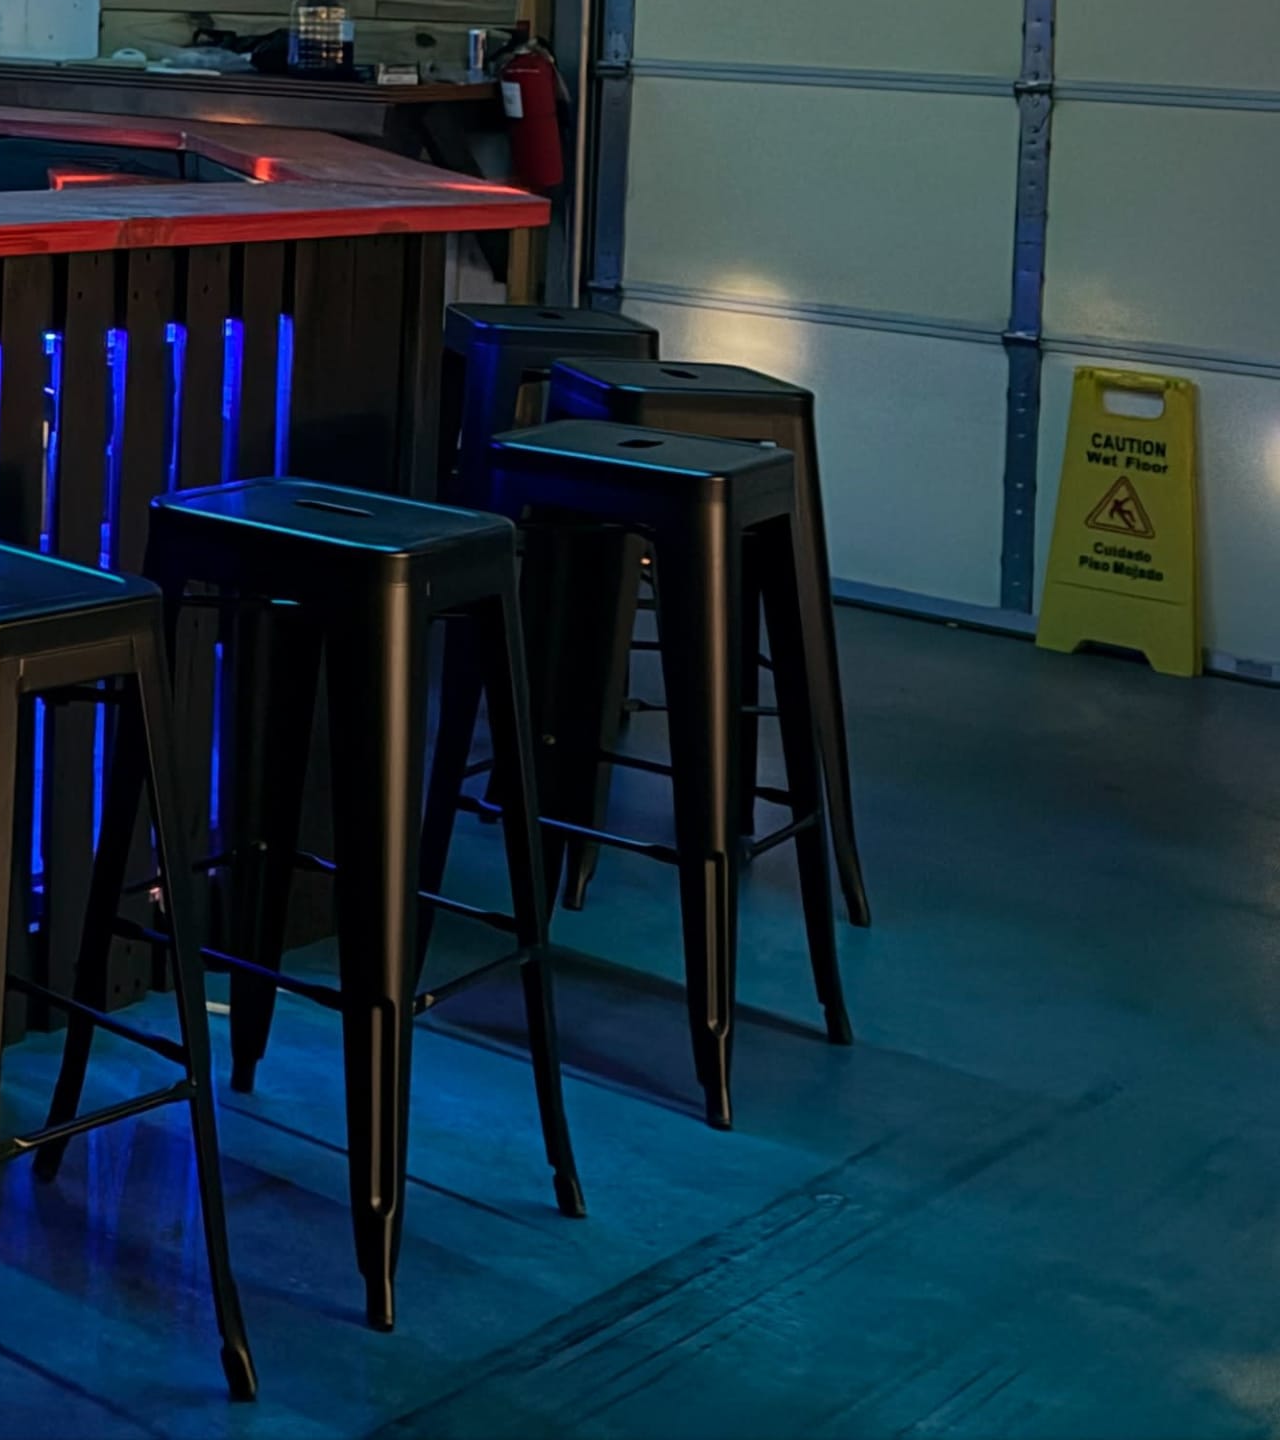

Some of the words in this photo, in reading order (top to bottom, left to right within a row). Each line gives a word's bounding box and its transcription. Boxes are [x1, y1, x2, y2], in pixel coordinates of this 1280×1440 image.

[1091, 432, 1167, 458] CAUTION
[1086, 450, 1118, 467] Wet
[1125, 456, 1168, 474] Floor
[1094, 542, 1152, 563] Cuidado
[1078, 555, 1110, 572] Piso
[1113, 561, 1164, 581] Mojado
